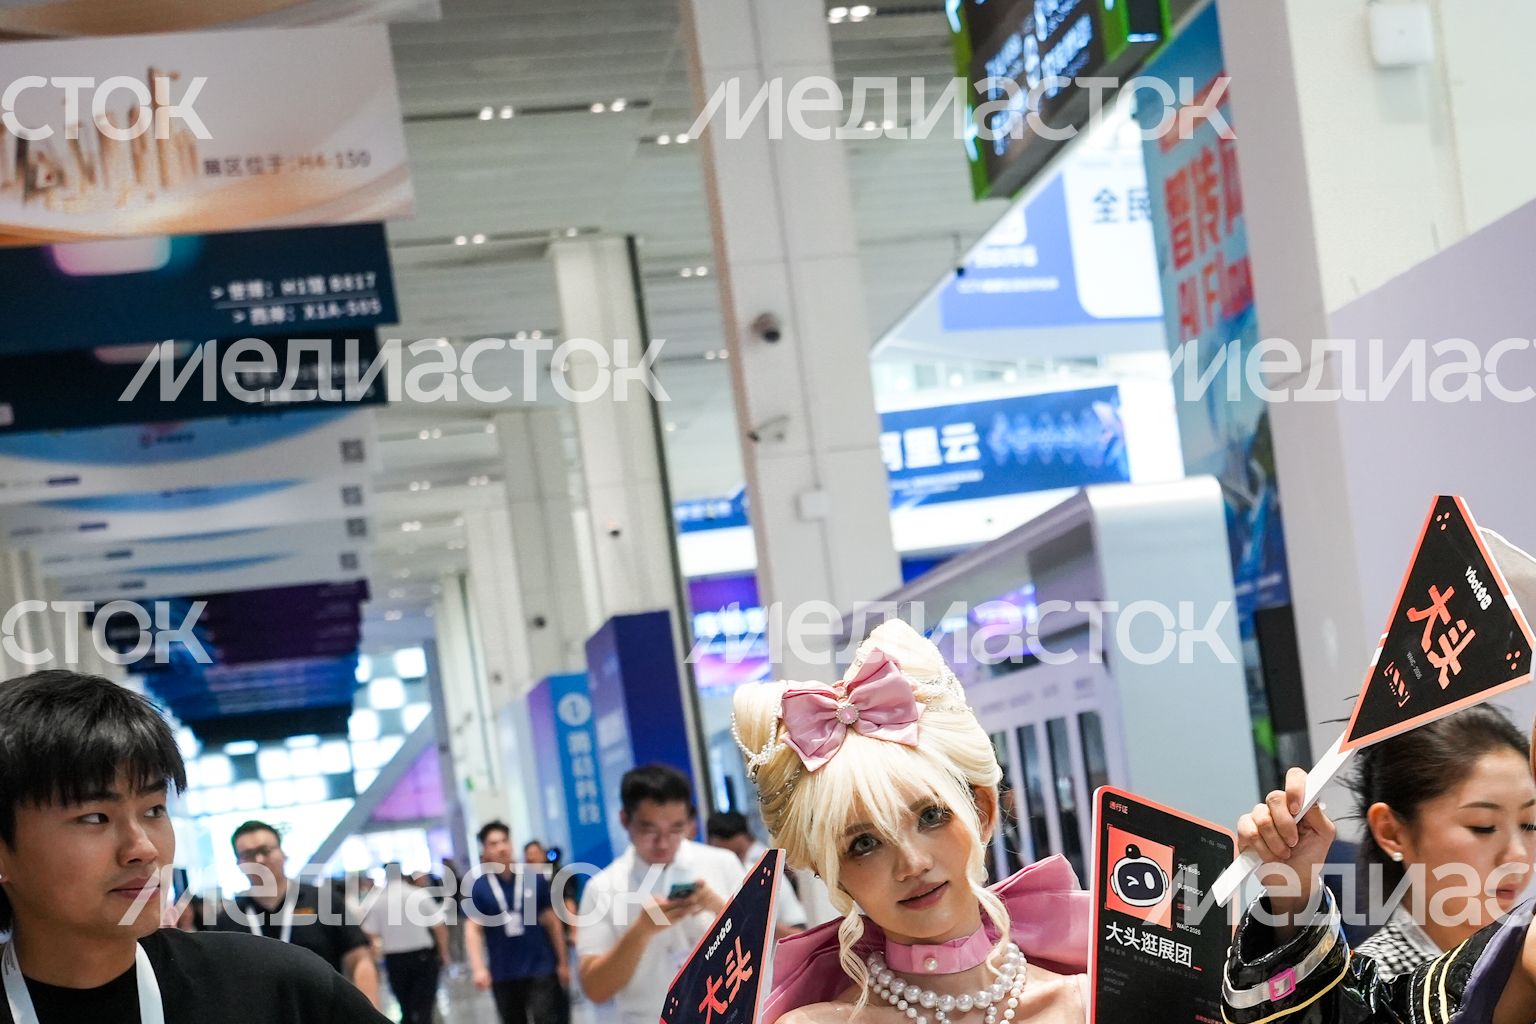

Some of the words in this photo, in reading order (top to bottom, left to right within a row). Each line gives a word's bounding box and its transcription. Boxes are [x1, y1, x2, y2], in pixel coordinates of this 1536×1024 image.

[1465, 566, 1483, 594] vbot
[1406, 584, 1477, 690] 大头
[704, 934, 721, 961] vbot
[1105, 921, 1192, 968] 大头逛展团
